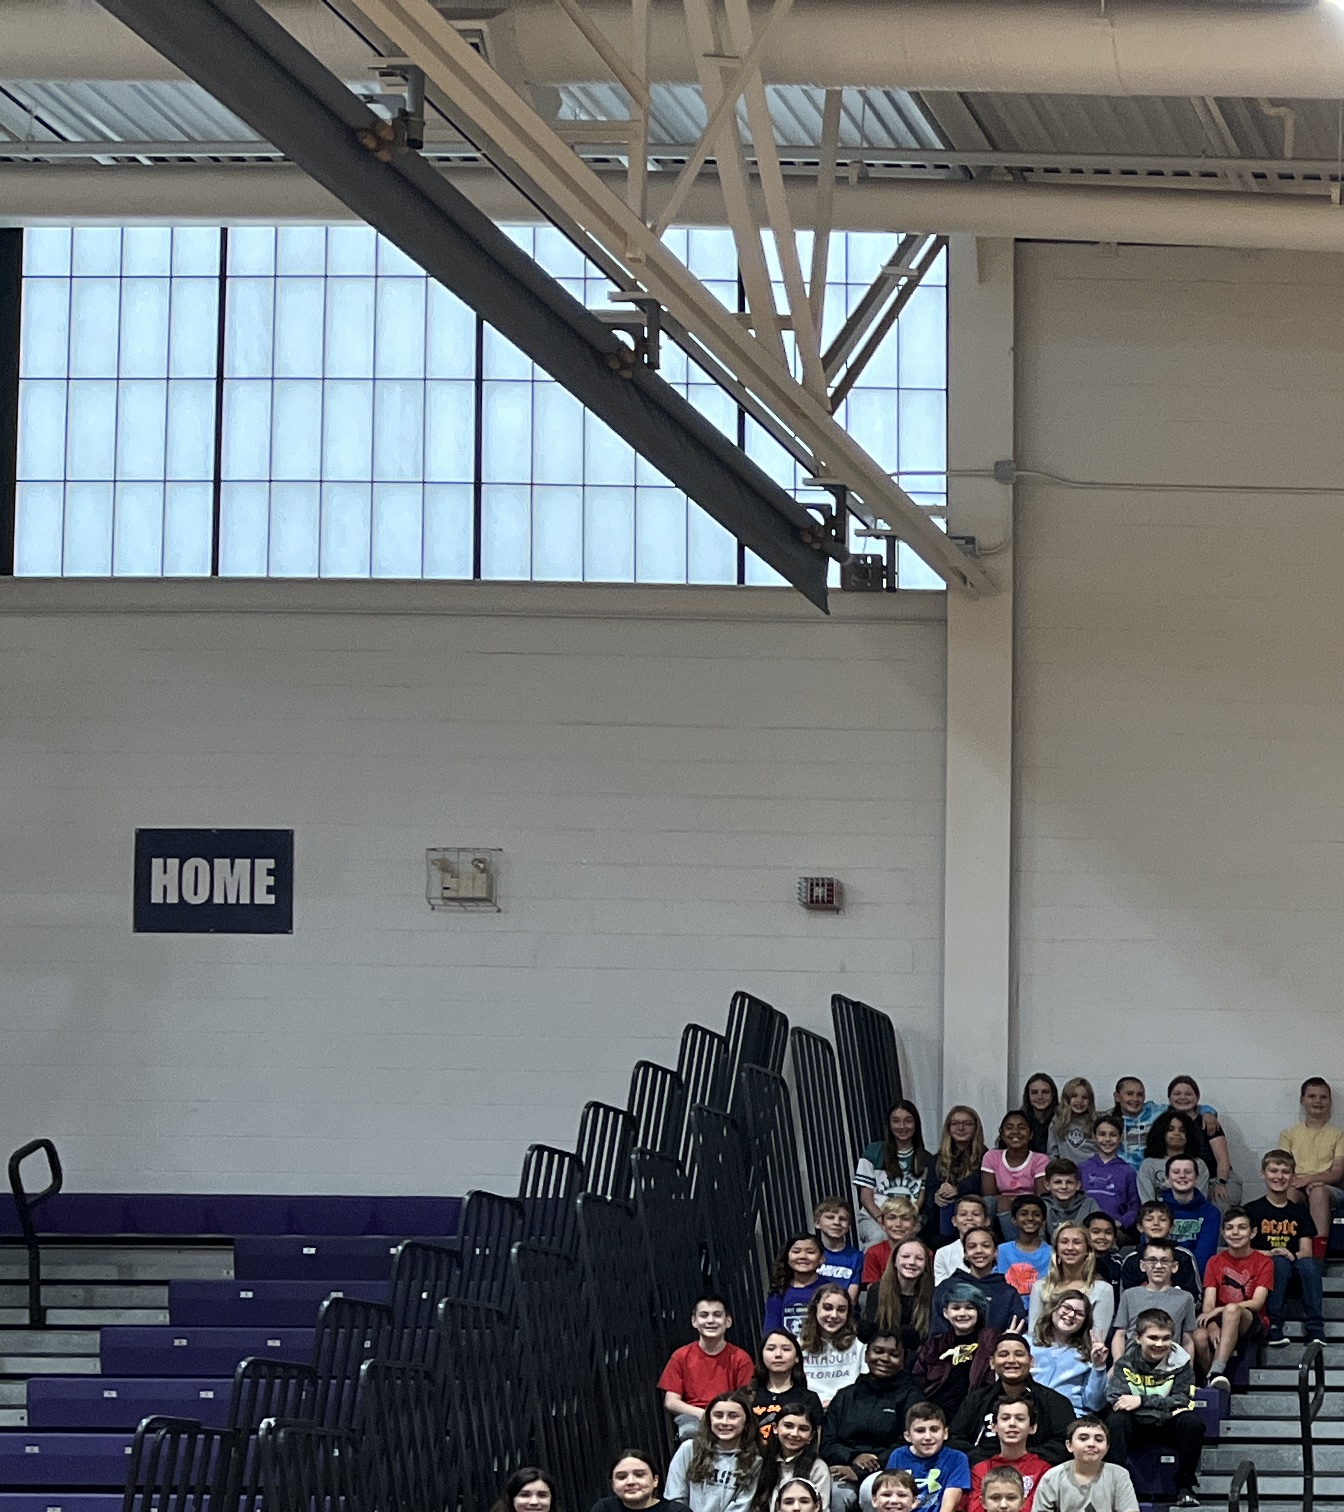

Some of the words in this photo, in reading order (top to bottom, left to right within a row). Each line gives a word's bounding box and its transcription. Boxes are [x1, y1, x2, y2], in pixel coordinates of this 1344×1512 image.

[151, 857, 276, 905] HOME
[1261, 1218, 1298, 1236] AC/DC
[805, 1369, 850, 1380] FLORIDA
